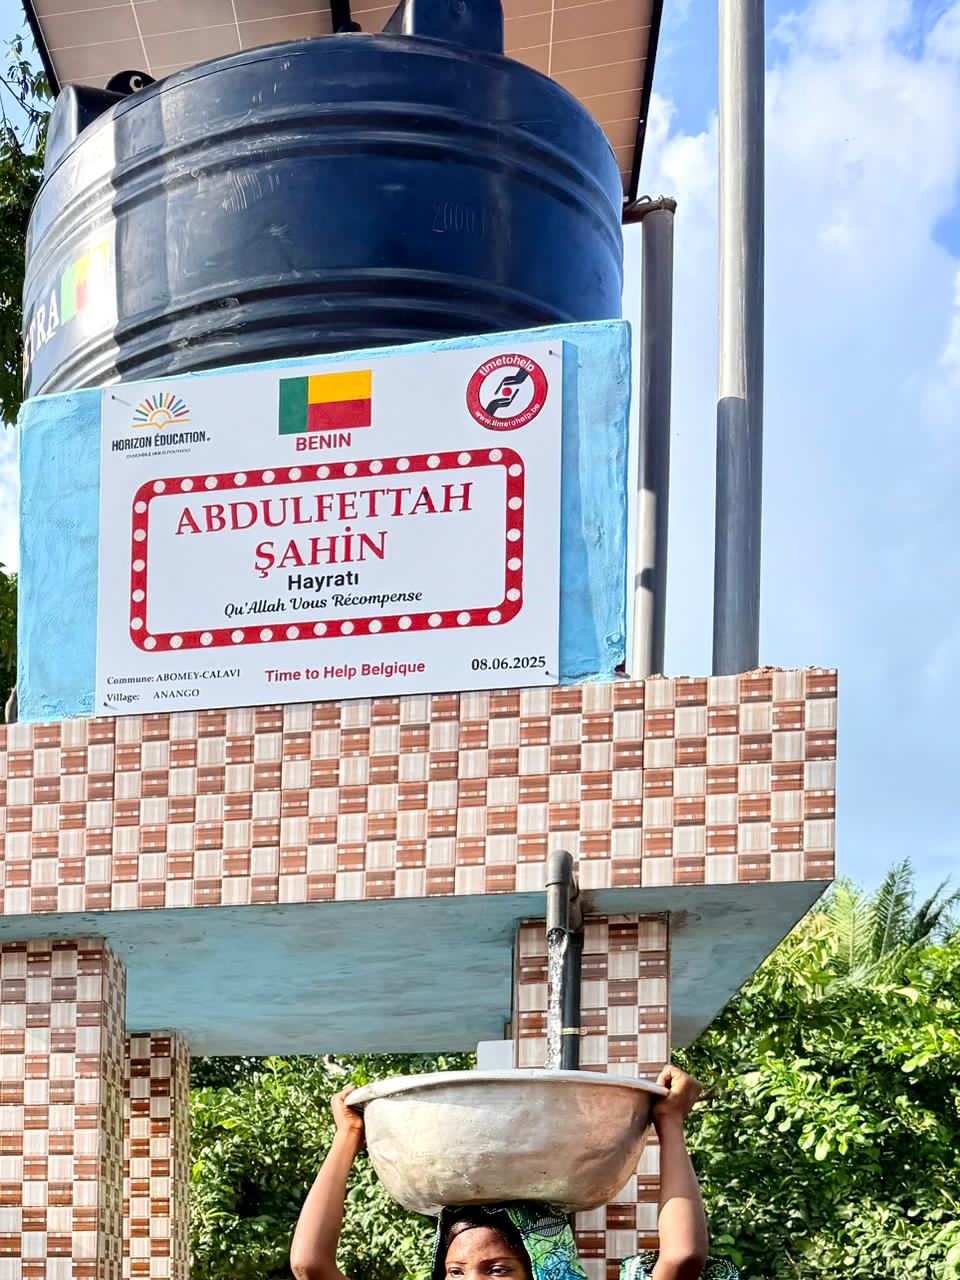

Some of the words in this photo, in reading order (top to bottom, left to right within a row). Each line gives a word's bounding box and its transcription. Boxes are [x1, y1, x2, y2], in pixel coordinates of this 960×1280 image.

[479, 355, 535, 376] timetohelp
[112, 436, 152, 452] HORIZON
[296, 432, 352, 452] BENIN
[175, 482, 473, 535] ABDULFETTAH
[254, 526, 389, 578] ŞAHİN
[287, 571, 359, 592] Hayratı
[224, 599, 286, 618] Qu'Allah
[290, 598, 328, 610] Vous
[332, 591, 423, 608] Récompense
[265, 670, 301, 683] Time
[305, 669, 320, 680] to
[324, 665, 357, 681] Help
[361, 661, 426, 678] Belgique
[471, 656, 547, 672] 08.06.2025
[106, 675, 154, 685] Commune:
[155, 669, 241, 683] ABOMEY-CALAVI
[106, 693, 140, 703] Village:
[153, 689, 200, 700] ANANGO
